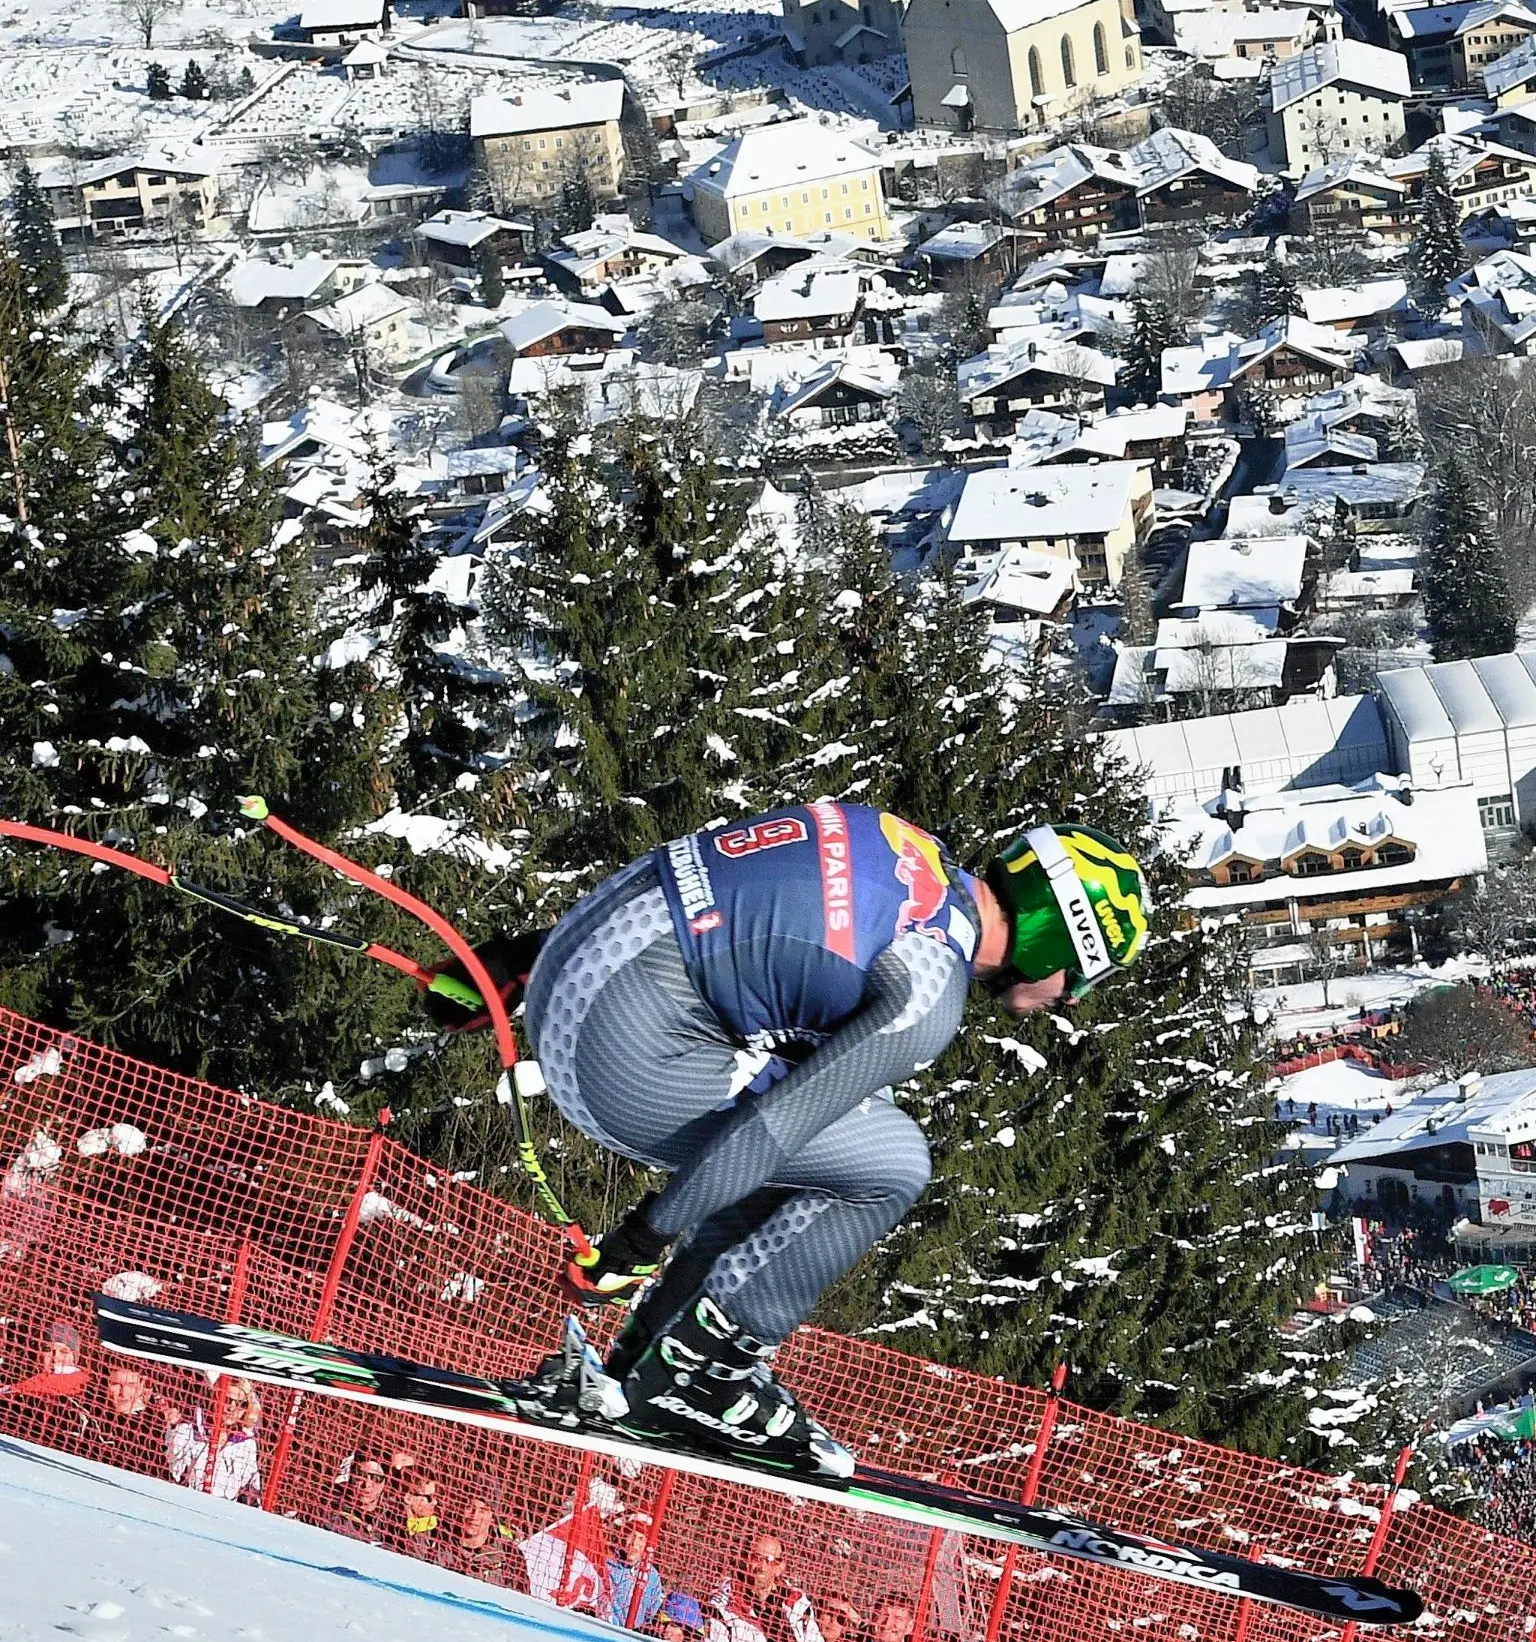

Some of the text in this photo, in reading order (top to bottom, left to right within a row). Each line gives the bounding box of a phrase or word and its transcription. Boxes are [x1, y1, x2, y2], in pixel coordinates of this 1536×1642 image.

[714, 817, 809, 859] 9
[823, 842, 851, 931] PARIS
[1068, 898, 1101, 967] uvex
[1095, 898, 1126, 949] uvex
[646, 1395, 770, 1446] NORDICA
[1050, 1528, 1241, 1589] NORDICA
